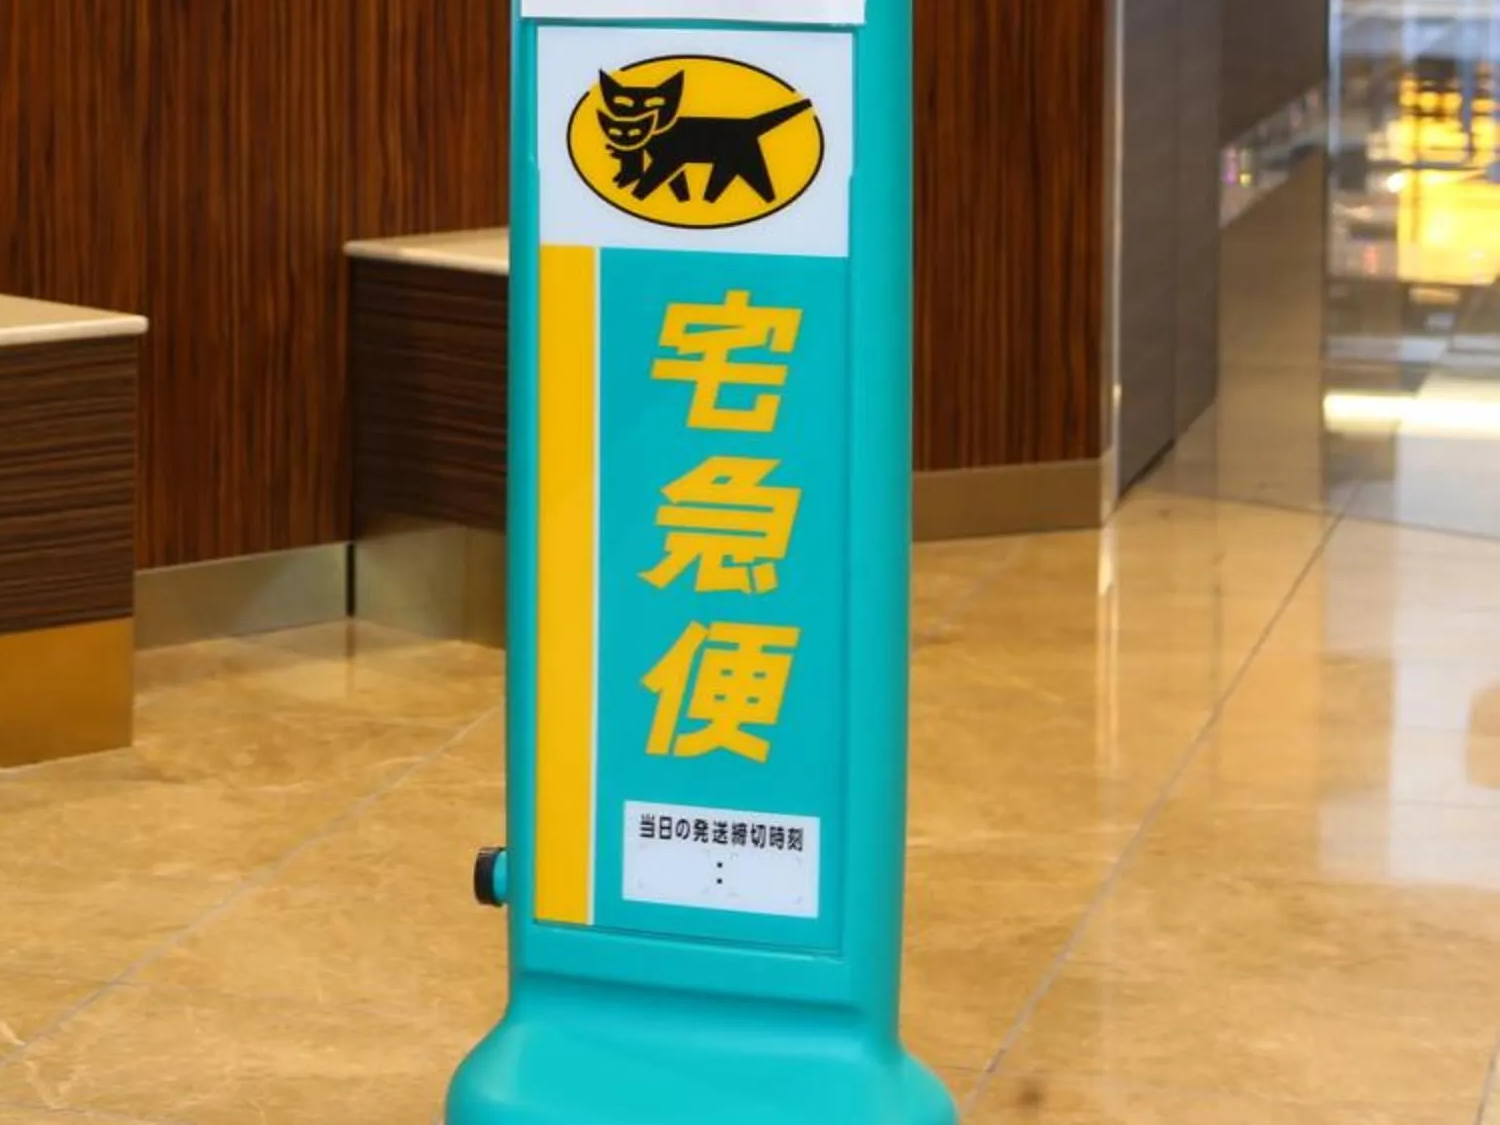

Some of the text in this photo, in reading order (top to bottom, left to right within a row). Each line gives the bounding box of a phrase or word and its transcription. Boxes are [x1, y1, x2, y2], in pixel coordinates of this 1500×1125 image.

[637, 289, 803, 764] 宅急便
[638, 812, 805, 852] 当日の発送締切時刻
